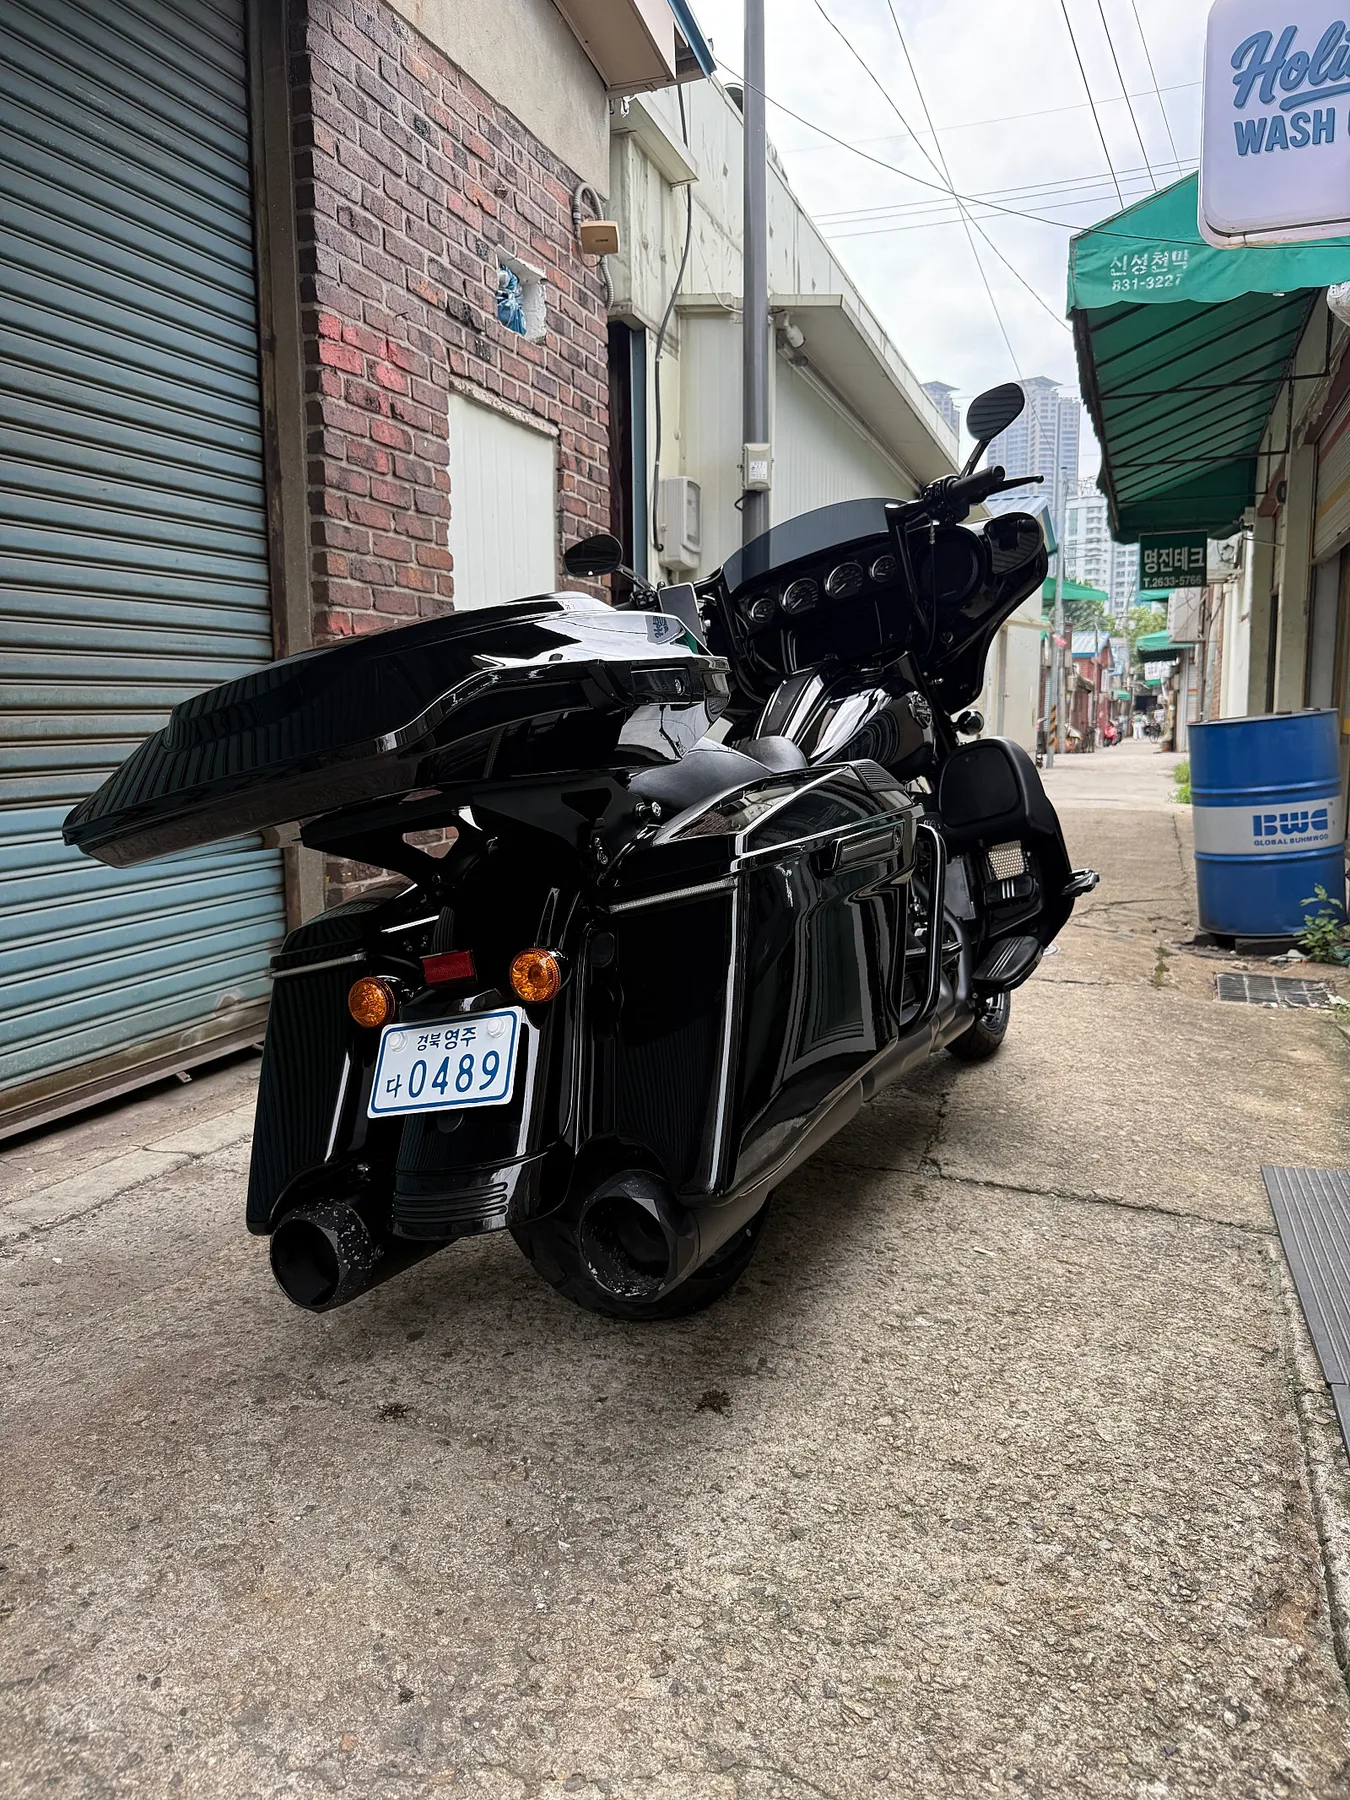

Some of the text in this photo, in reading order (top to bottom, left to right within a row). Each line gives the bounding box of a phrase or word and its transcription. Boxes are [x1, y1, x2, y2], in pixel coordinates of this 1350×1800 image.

[1230, 20, 1350, 109] Holi
[1233, 107, 1336, 156] WASH
[1110, 249, 1189, 276] 신성천막
[1112, 273, 1184, 292] 831-3227
[1144, 546, 1205, 573] 명진테크
[1253, 838, 1288, 847] GLOBAL
